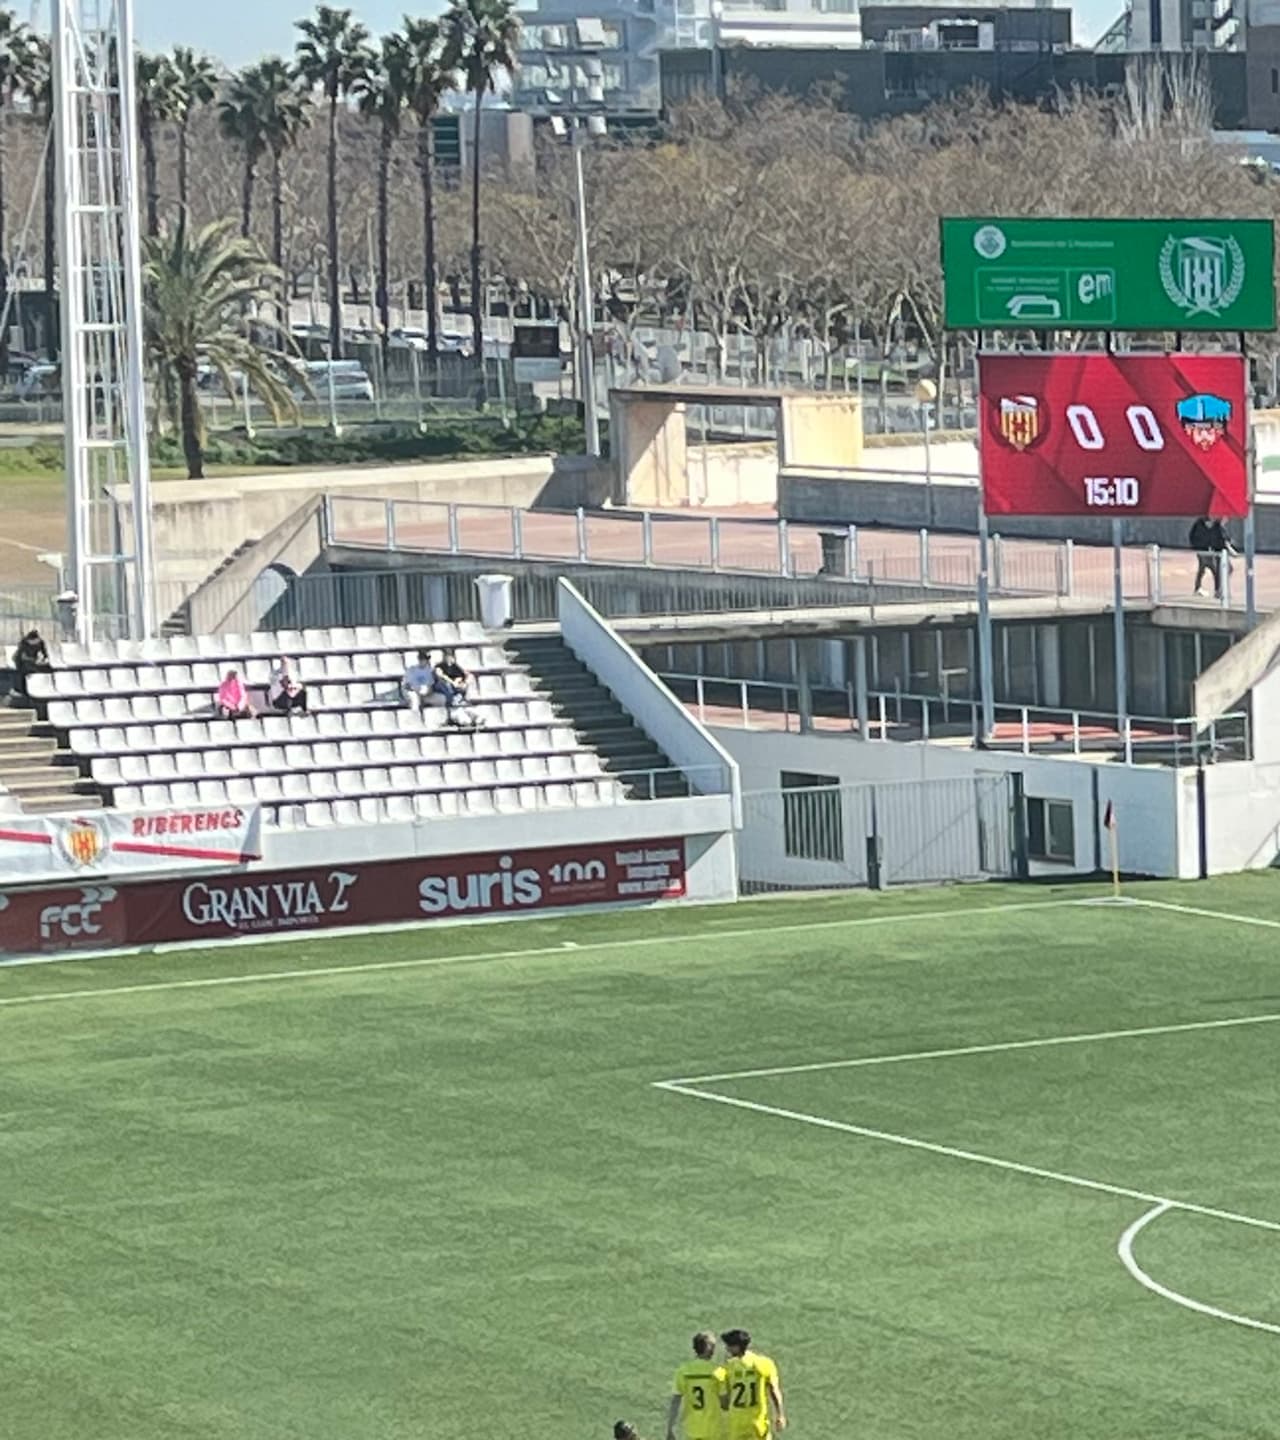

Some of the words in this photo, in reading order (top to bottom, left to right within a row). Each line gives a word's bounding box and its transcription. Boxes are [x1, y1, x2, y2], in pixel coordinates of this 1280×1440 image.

[1066, 405, 1105, 449] 0
[1126, 405, 1165, 450] 0
[1084, 477, 1139, 506] 15:10
[182, 882, 271, 927] GRAN
[272, 880, 326, 916] VIA
[328, 871, 358, 912] 2
[419, 855, 542, 912] suris
[692, 1385, 705, 1411] 3
[732, 1381, 760, 1408] 21
